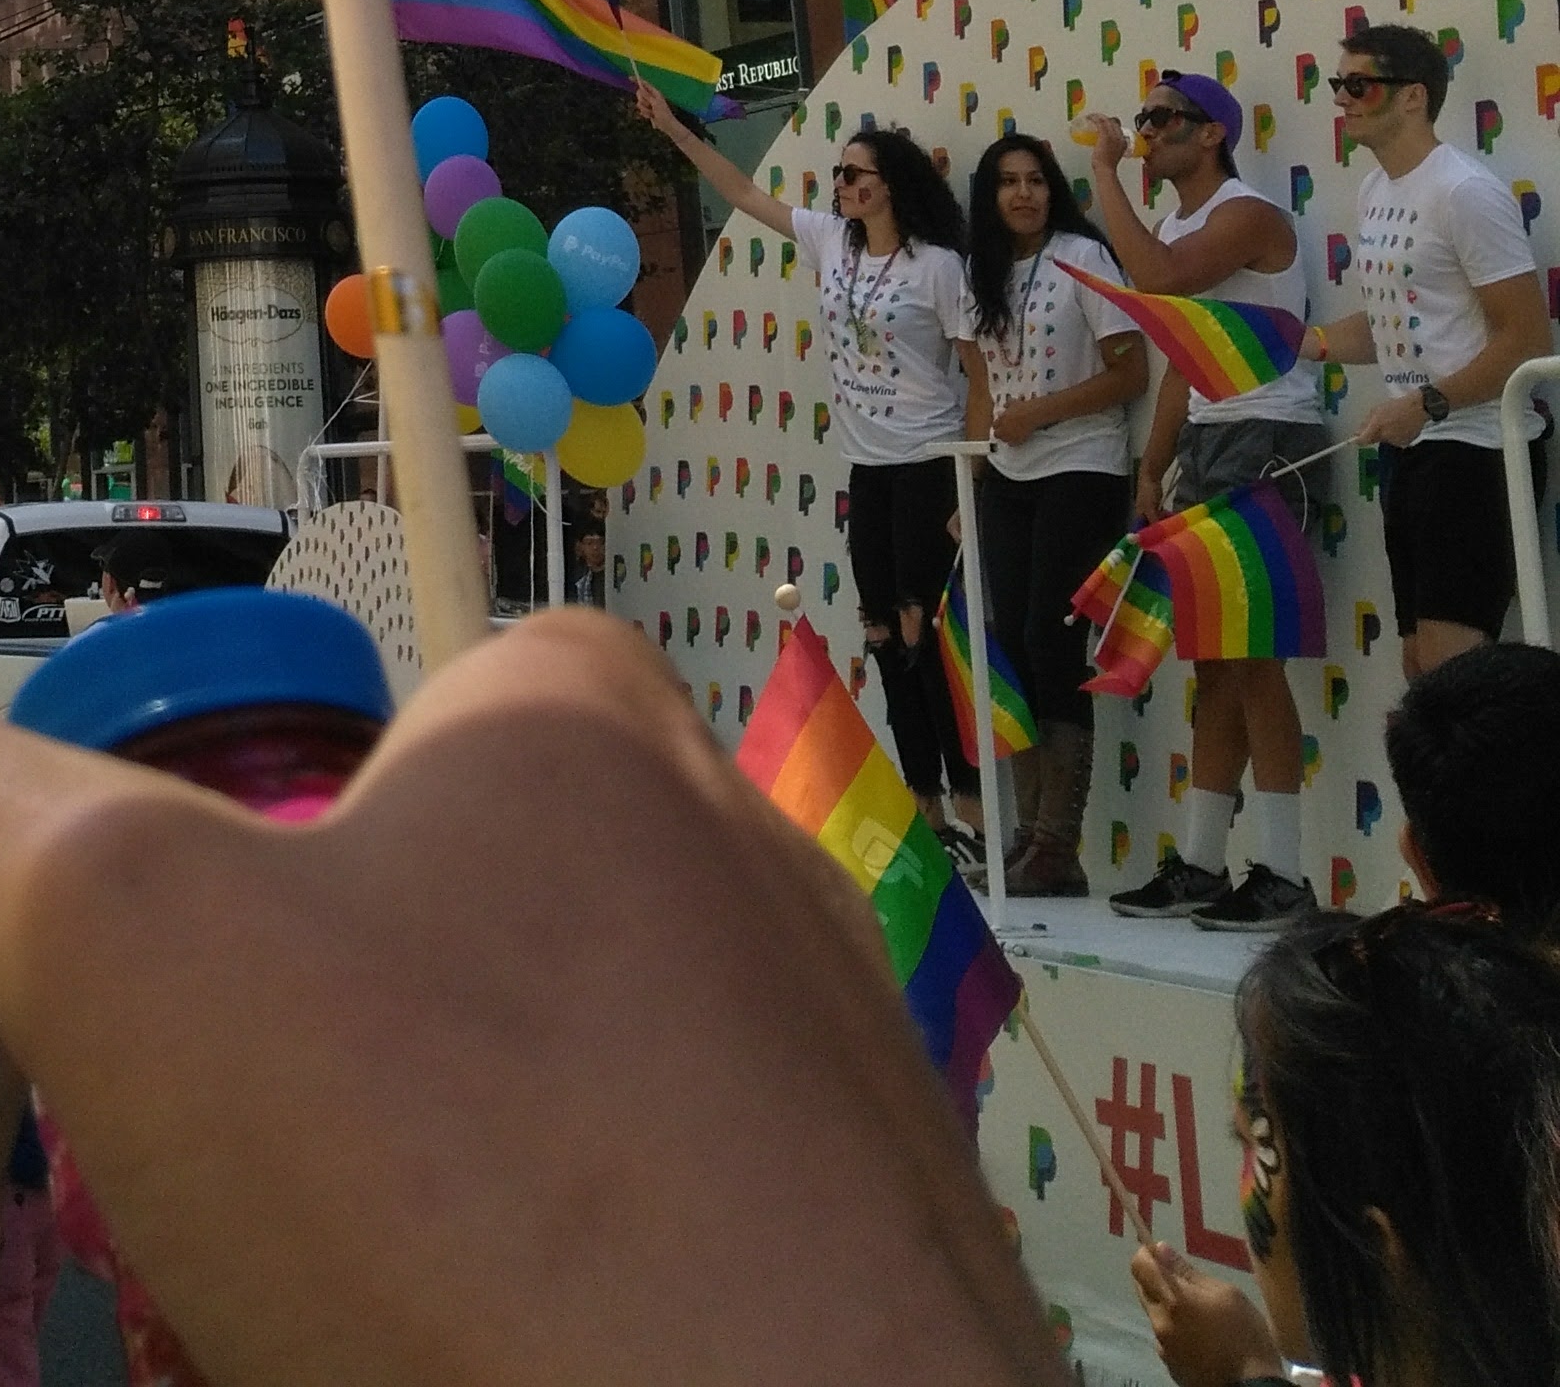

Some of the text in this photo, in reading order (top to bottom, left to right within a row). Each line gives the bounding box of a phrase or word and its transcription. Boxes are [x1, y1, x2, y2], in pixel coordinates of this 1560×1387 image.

[189, 227, 307, 245] SAN FRANCISCO
[211, 302, 302, 325] Häagen-Dazs
[220, 362, 305, 376] INGREDIENTS
[205, 378, 315, 394] ONE INCREDIBLE
[215, 395, 304, 410] INDULGENCE
